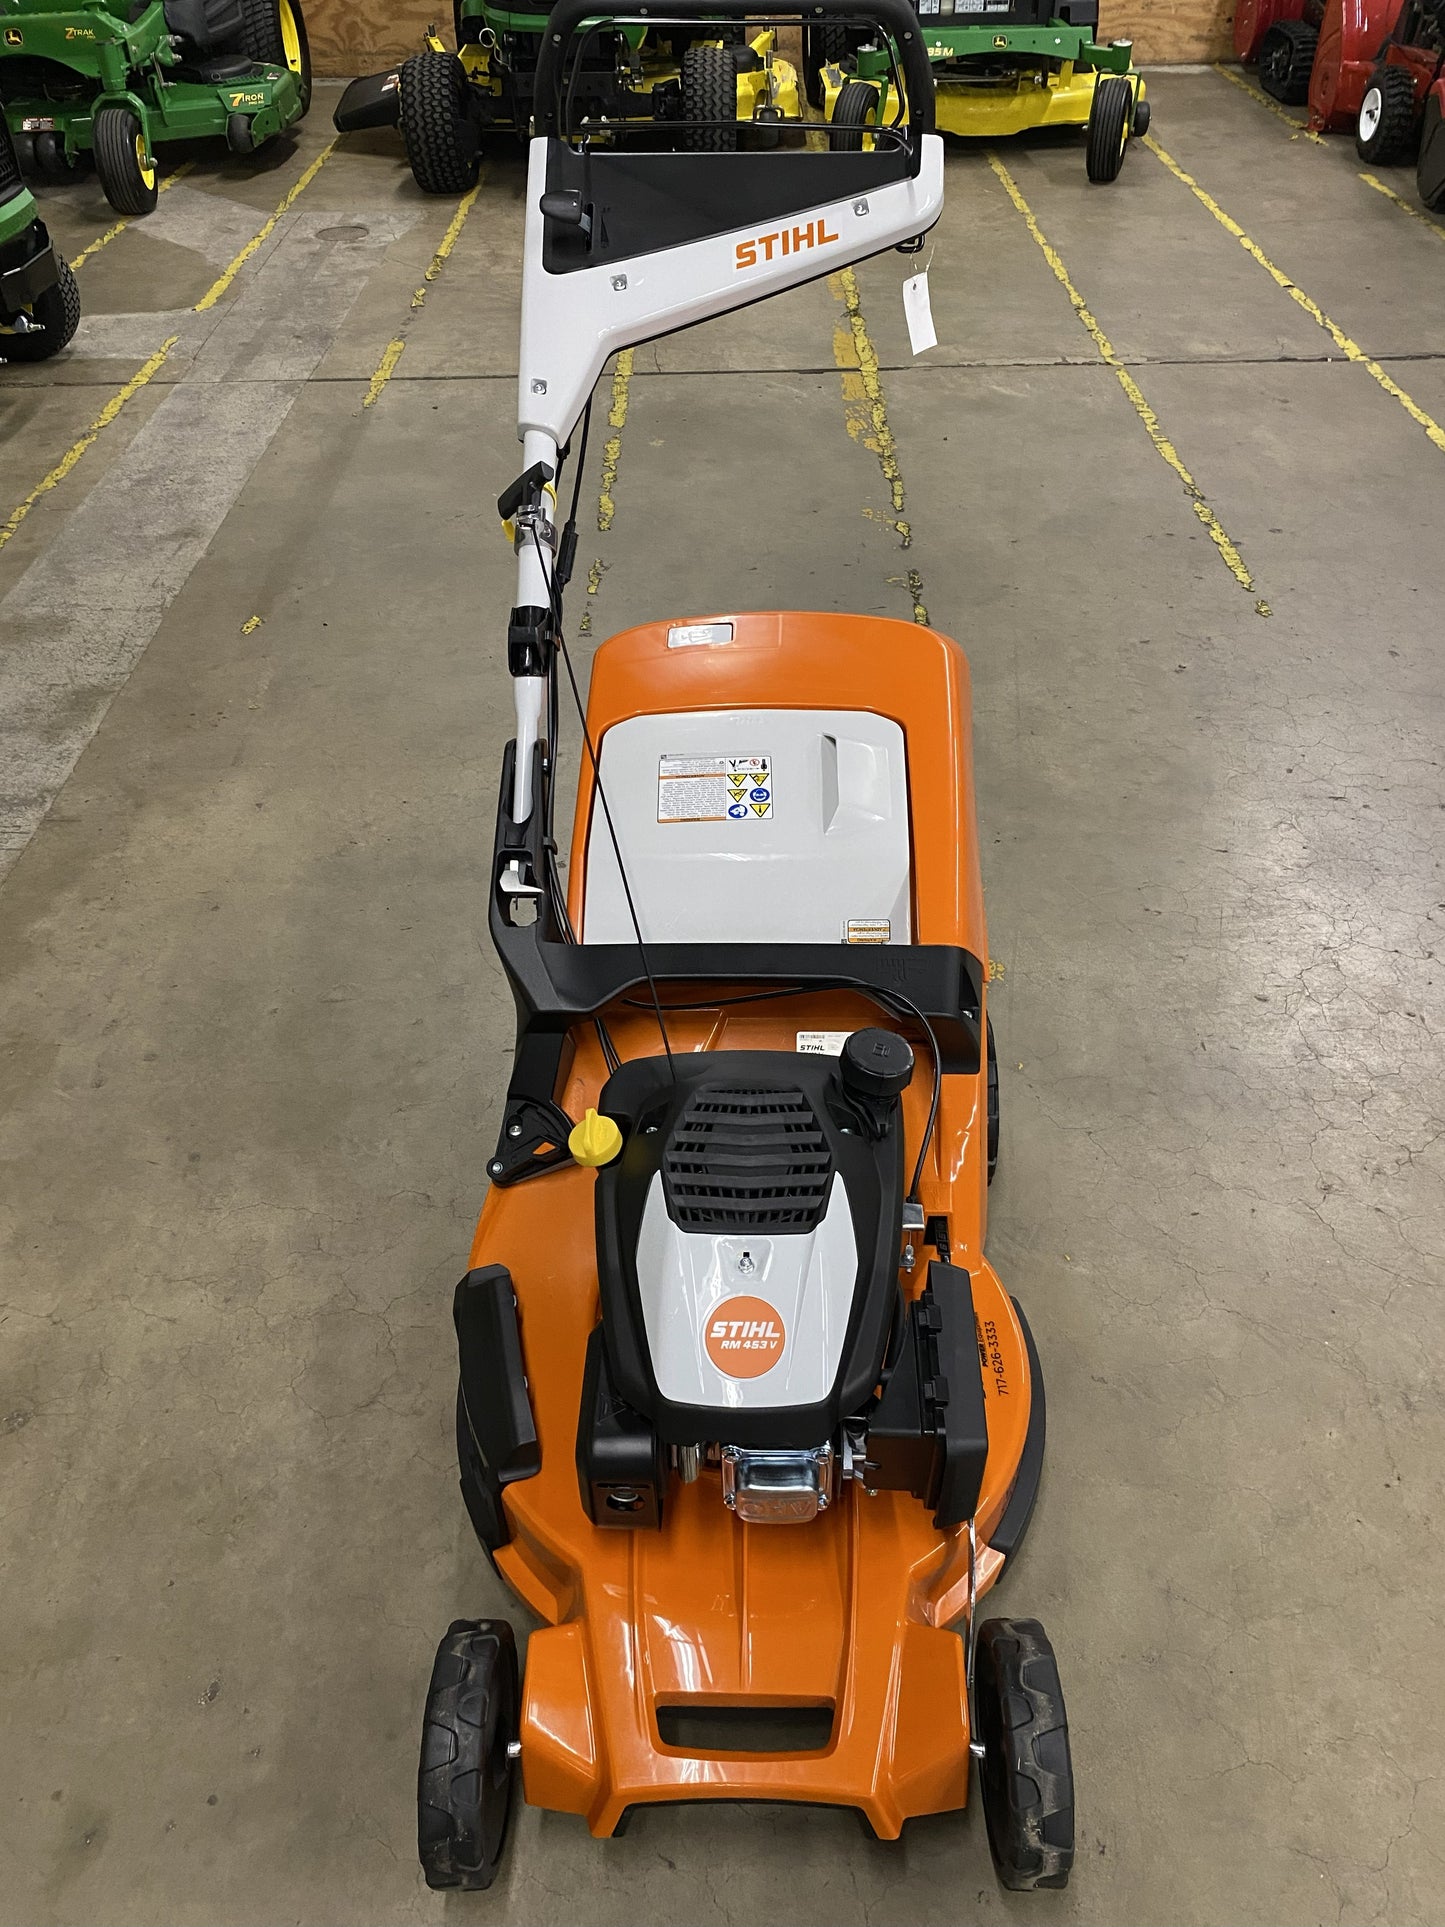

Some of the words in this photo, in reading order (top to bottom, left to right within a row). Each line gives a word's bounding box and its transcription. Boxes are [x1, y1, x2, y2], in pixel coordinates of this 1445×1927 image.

[735, 219, 839, 270] STIHL
[710, 1321, 781, 1338] STIHL
[720, 1340, 741, 1350] RM
[742, 1340, 767, 1350] 453
[769, 1340, 778, 1350] V
[984, 1321, 1009, 1395] 717-626-3333
